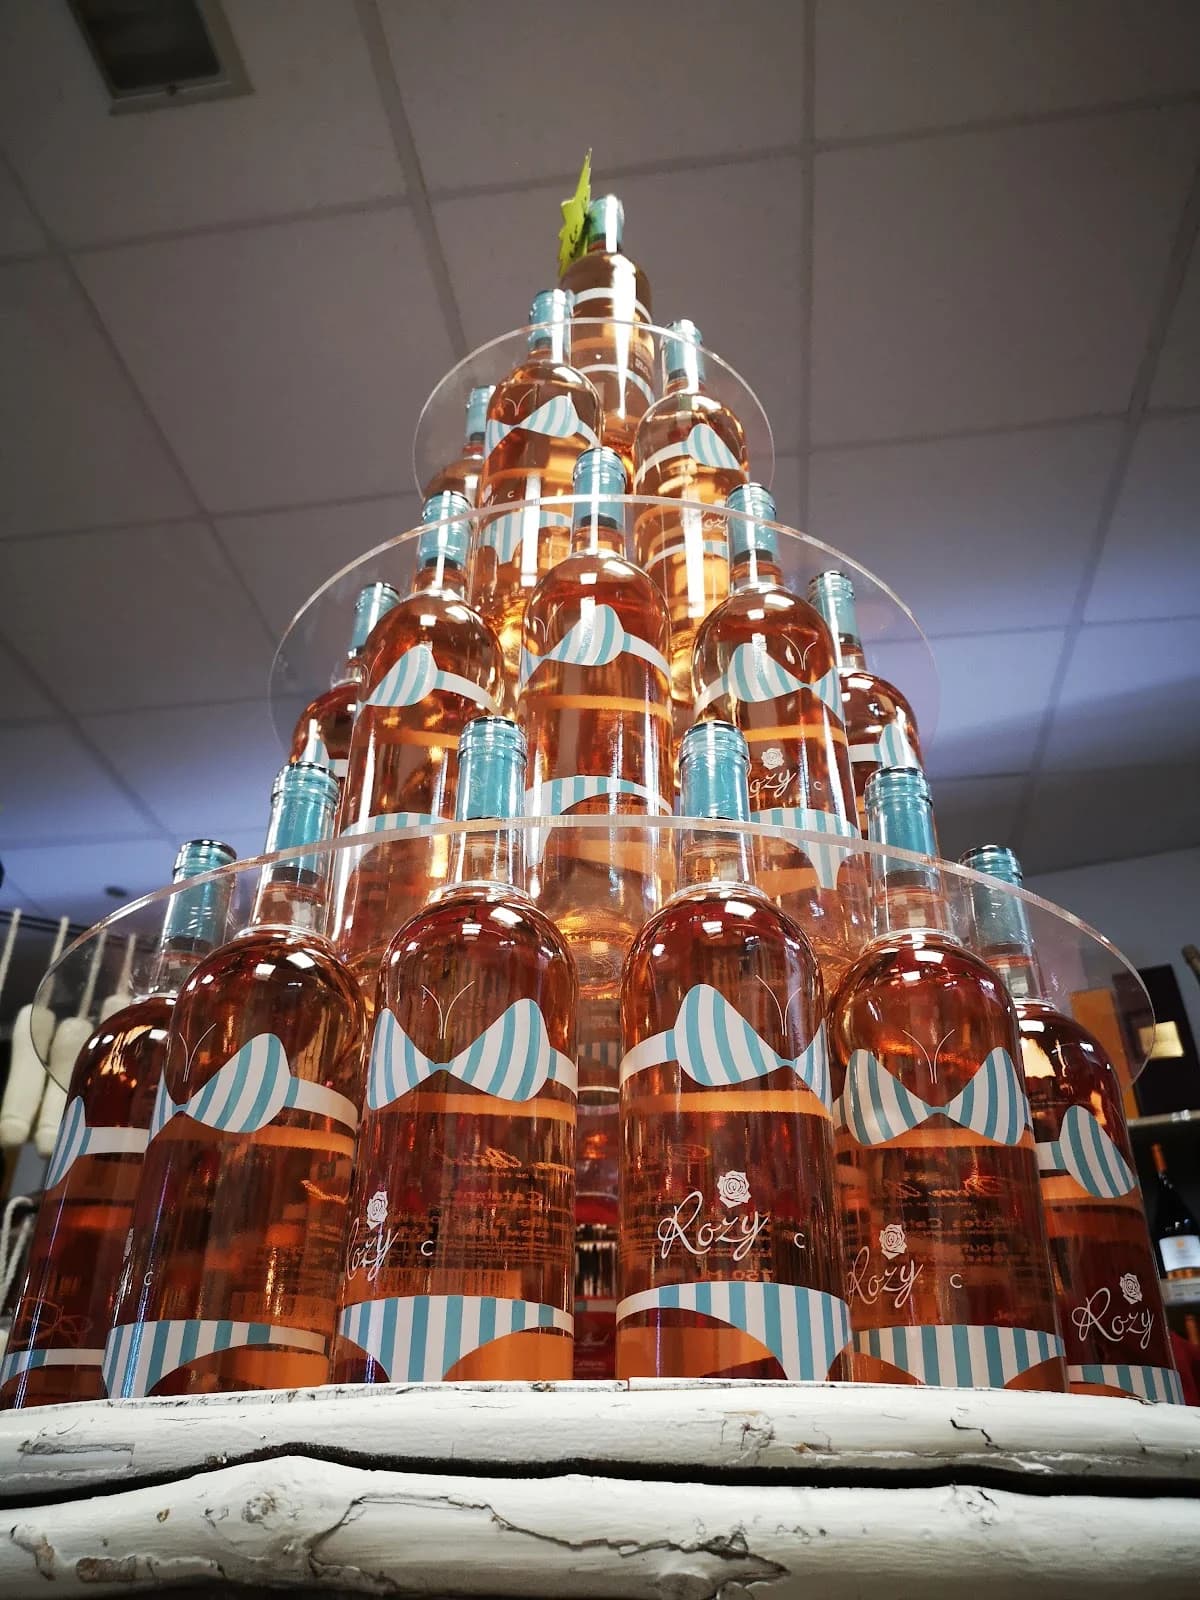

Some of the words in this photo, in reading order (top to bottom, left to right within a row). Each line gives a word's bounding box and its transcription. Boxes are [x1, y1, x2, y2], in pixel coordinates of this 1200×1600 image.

[745, 763, 797, 798] ozy
[658, 1190, 768, 1262] Rozy
[793, 1232, 806, 1249] C
[421, 1240, 434, 1256] C
[847, 1246, 924, 1309] Rozy
[949, 1273, 963, 1289] C
[1071, 1287, 1154, 1350] Rozy
